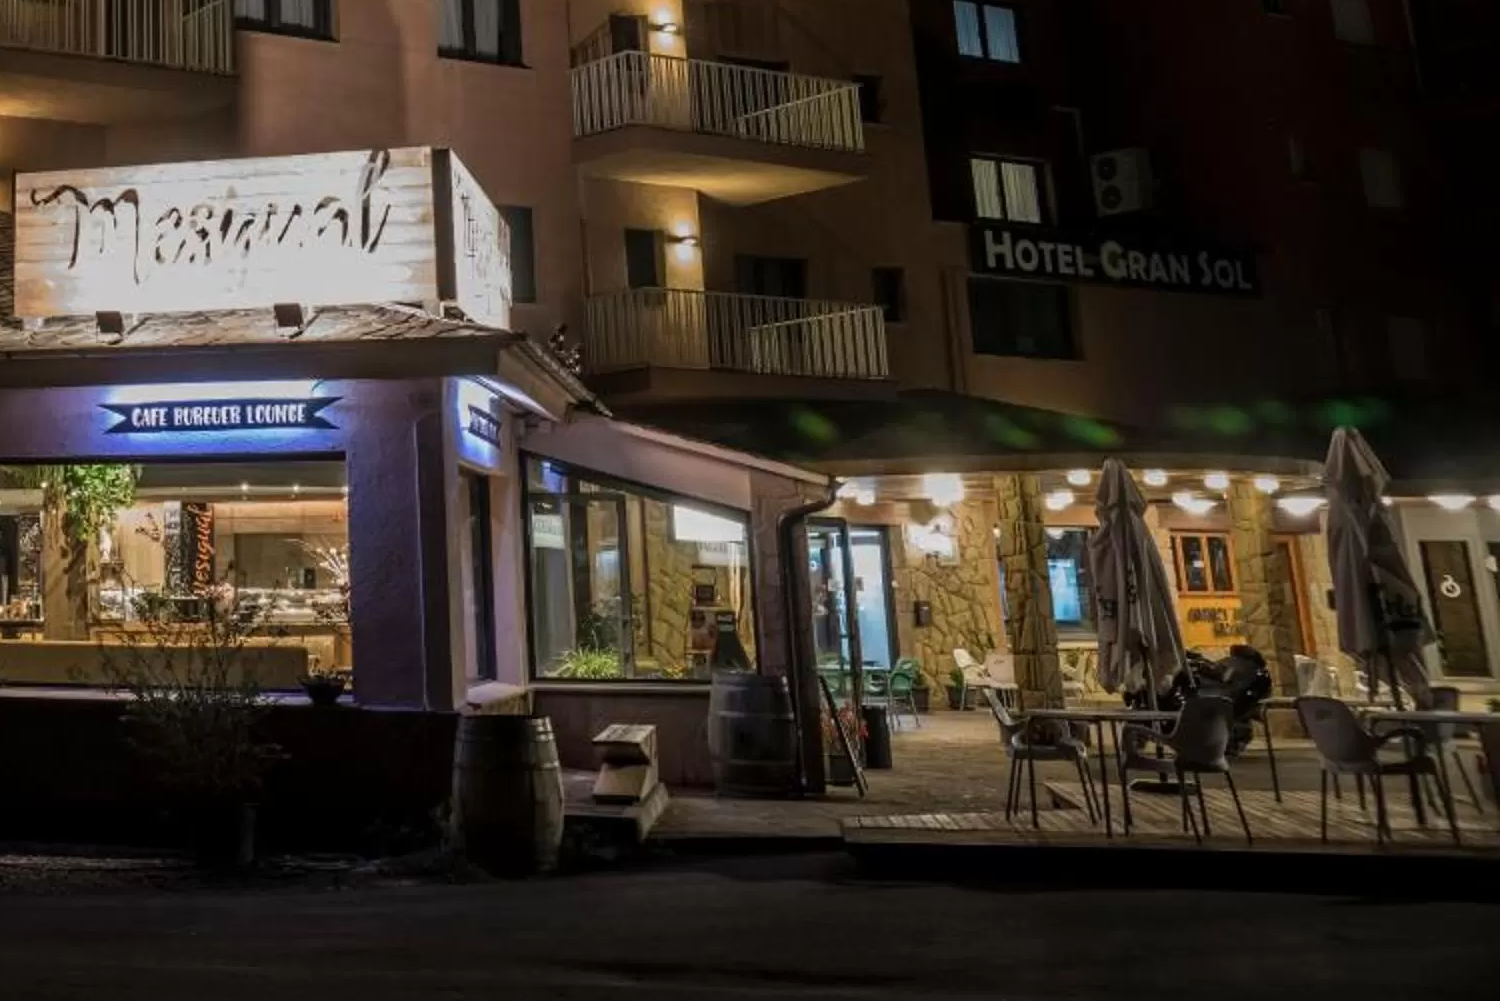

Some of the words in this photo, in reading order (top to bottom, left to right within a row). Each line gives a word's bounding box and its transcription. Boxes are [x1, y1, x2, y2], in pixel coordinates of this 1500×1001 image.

[984, 230, 1094, 277] HOTEL
[1101, 241, 1191, 284] GRAN
[1198, 250, 1252, 290] SOL
[132, 407, 168, 428] CAFE
[246, 403, 307, 424] LOUNGE
